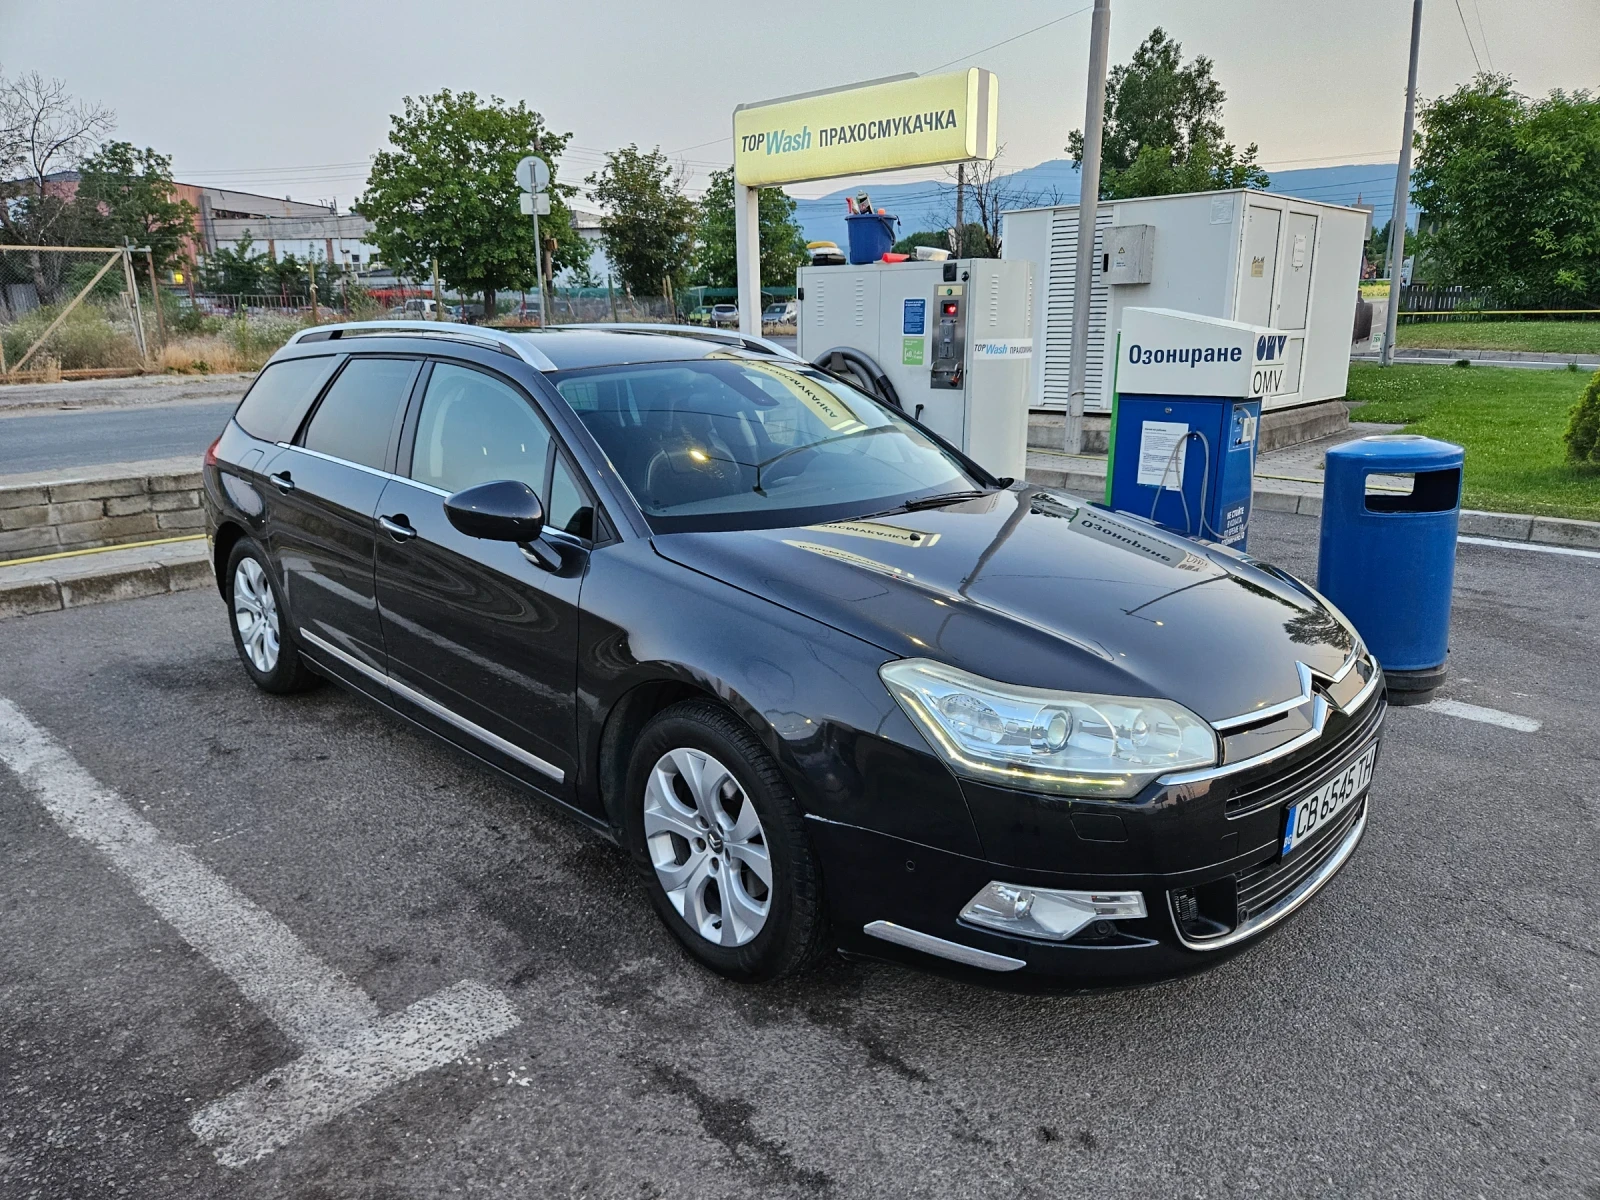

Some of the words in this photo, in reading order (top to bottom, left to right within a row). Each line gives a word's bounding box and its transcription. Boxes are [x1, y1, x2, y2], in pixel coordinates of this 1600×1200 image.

[819, 109, 957, 147] ПРАХОСМУКАЧКА
[1128, 344, 1242, 368] Озониране
[1256, 334, 1288, 361] OMV
[1252, 369, 1283, 395] OMV
[1296, 795, 1319, 839] CB
[1320, 765, 1356, 820] 6545
[1357, 749, 1375, 790] TH
